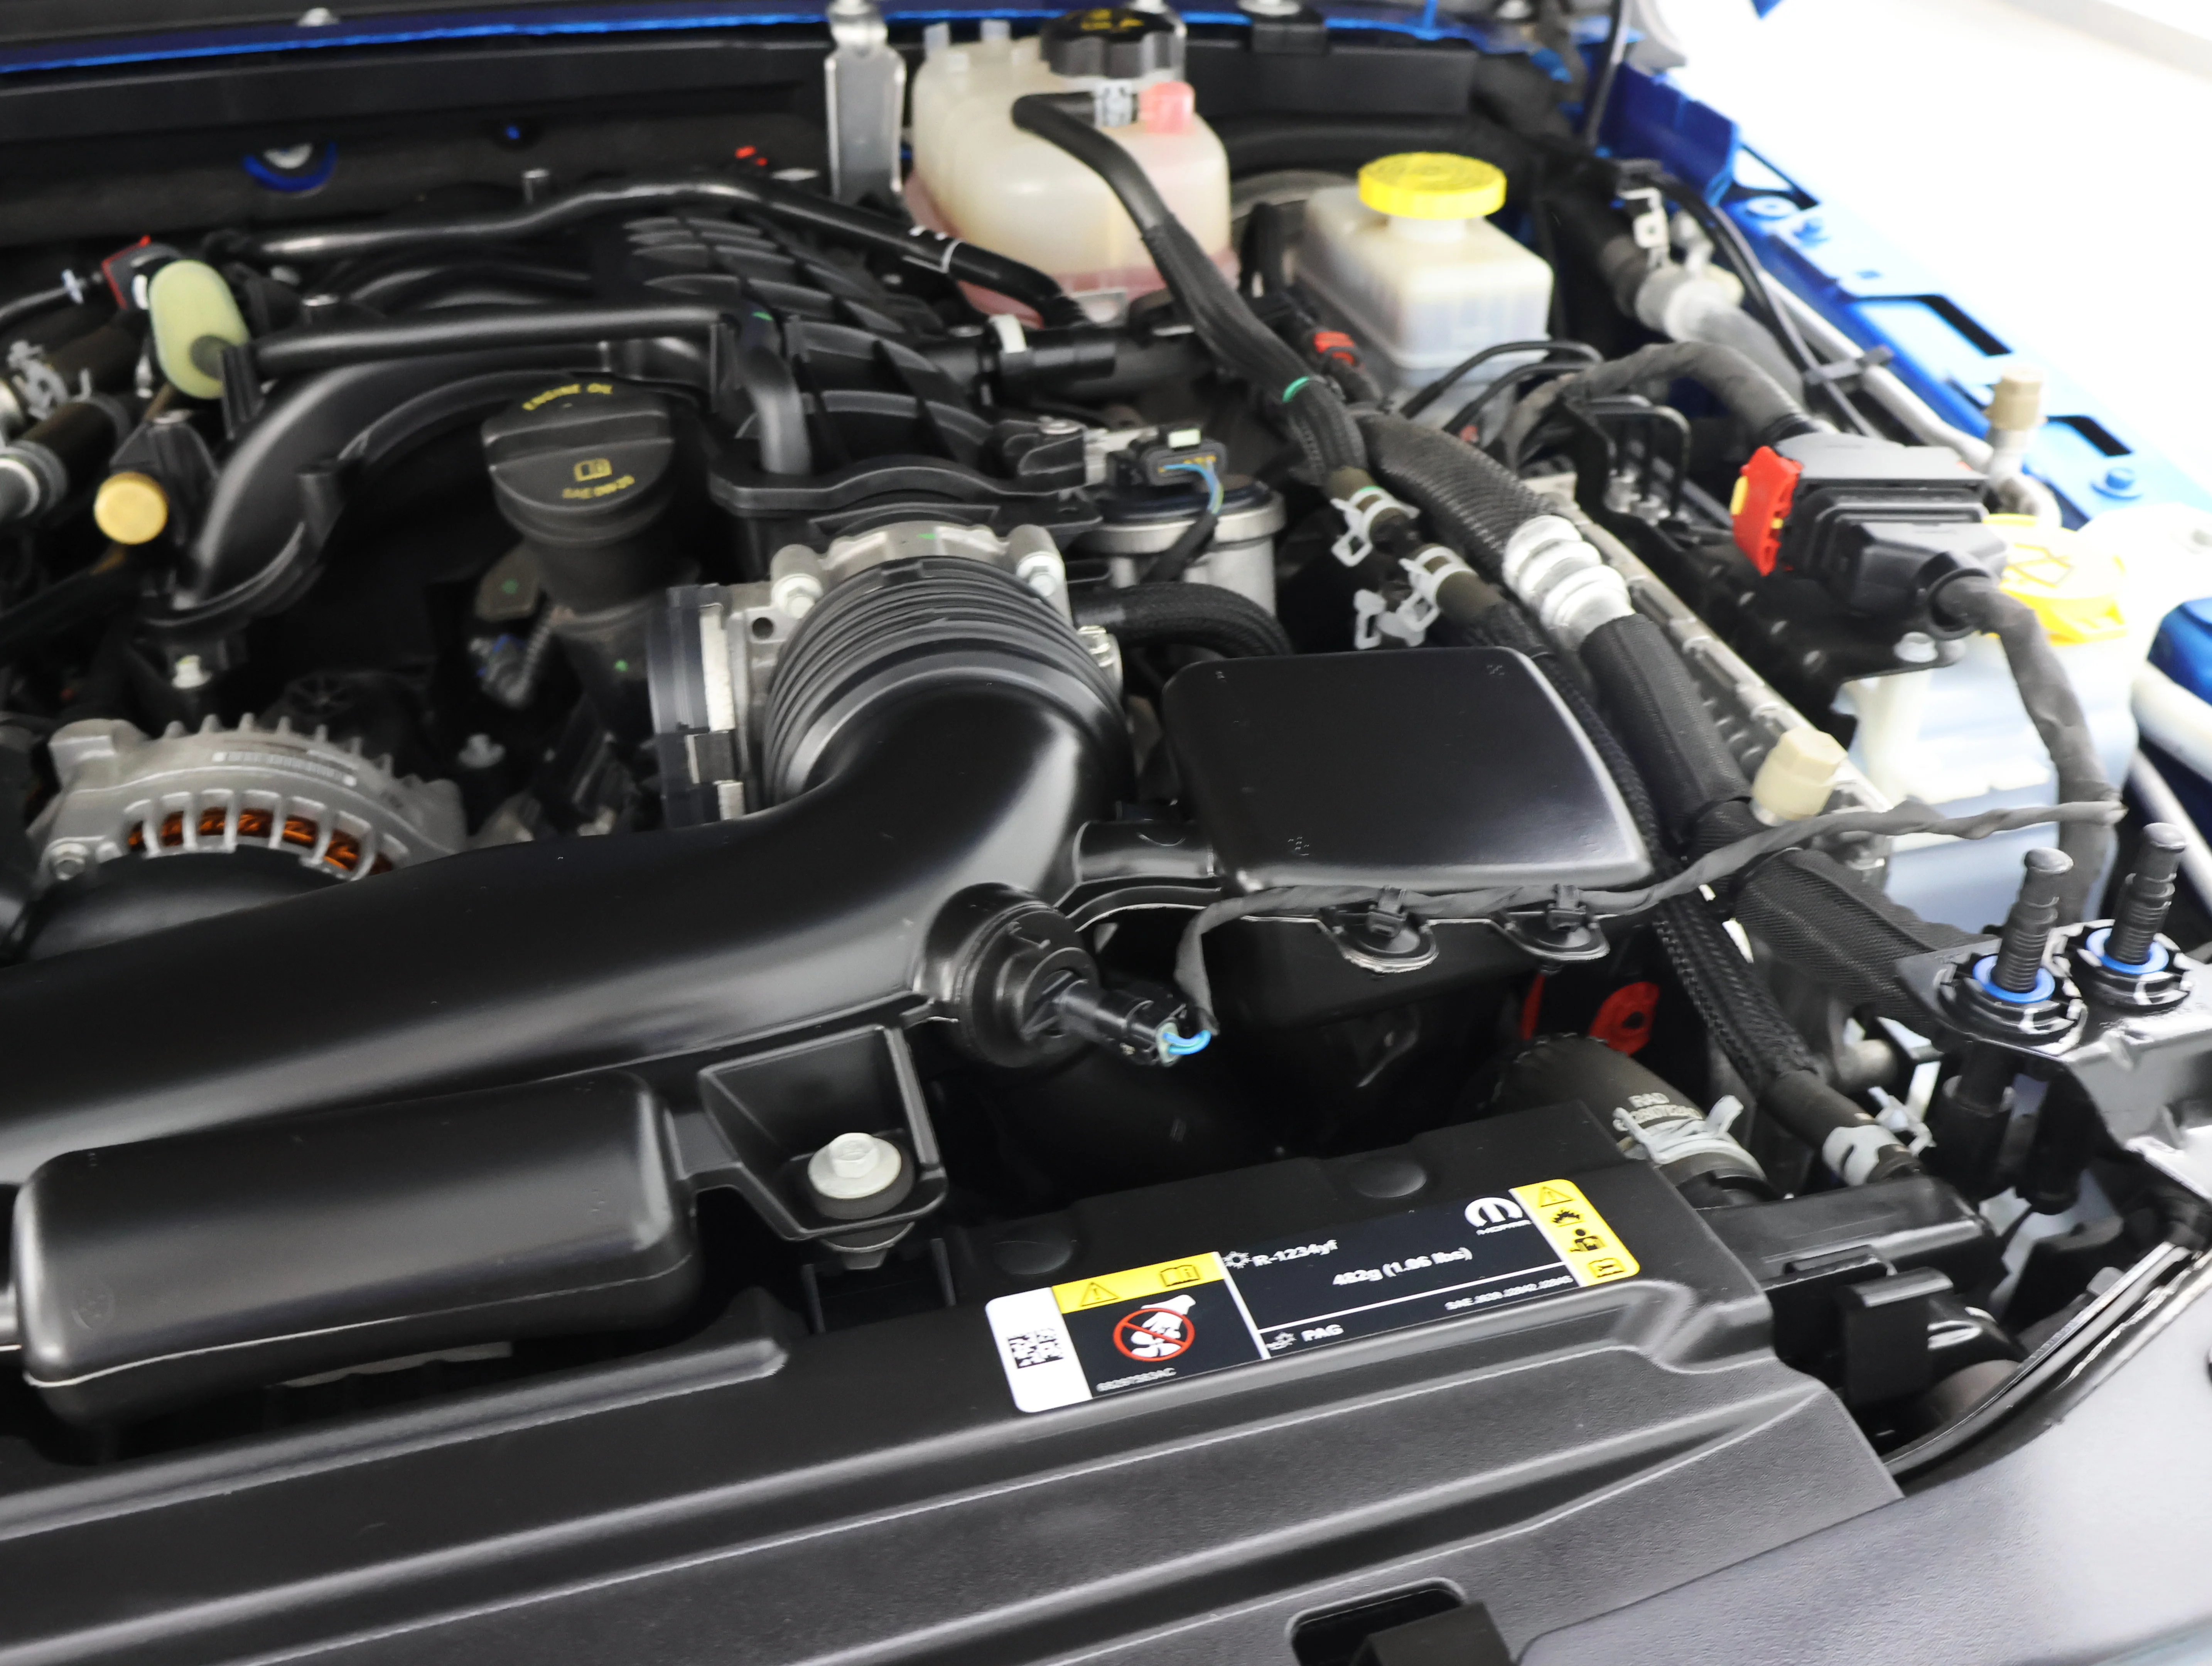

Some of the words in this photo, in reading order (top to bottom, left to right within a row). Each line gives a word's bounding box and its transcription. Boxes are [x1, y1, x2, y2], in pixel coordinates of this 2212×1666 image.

[1251, 1239, 1338, 1267] R-1234yf
[1430, 1247, 1473, 1265] lbs)
[1300, 1324, 1345, 1342] PAG
